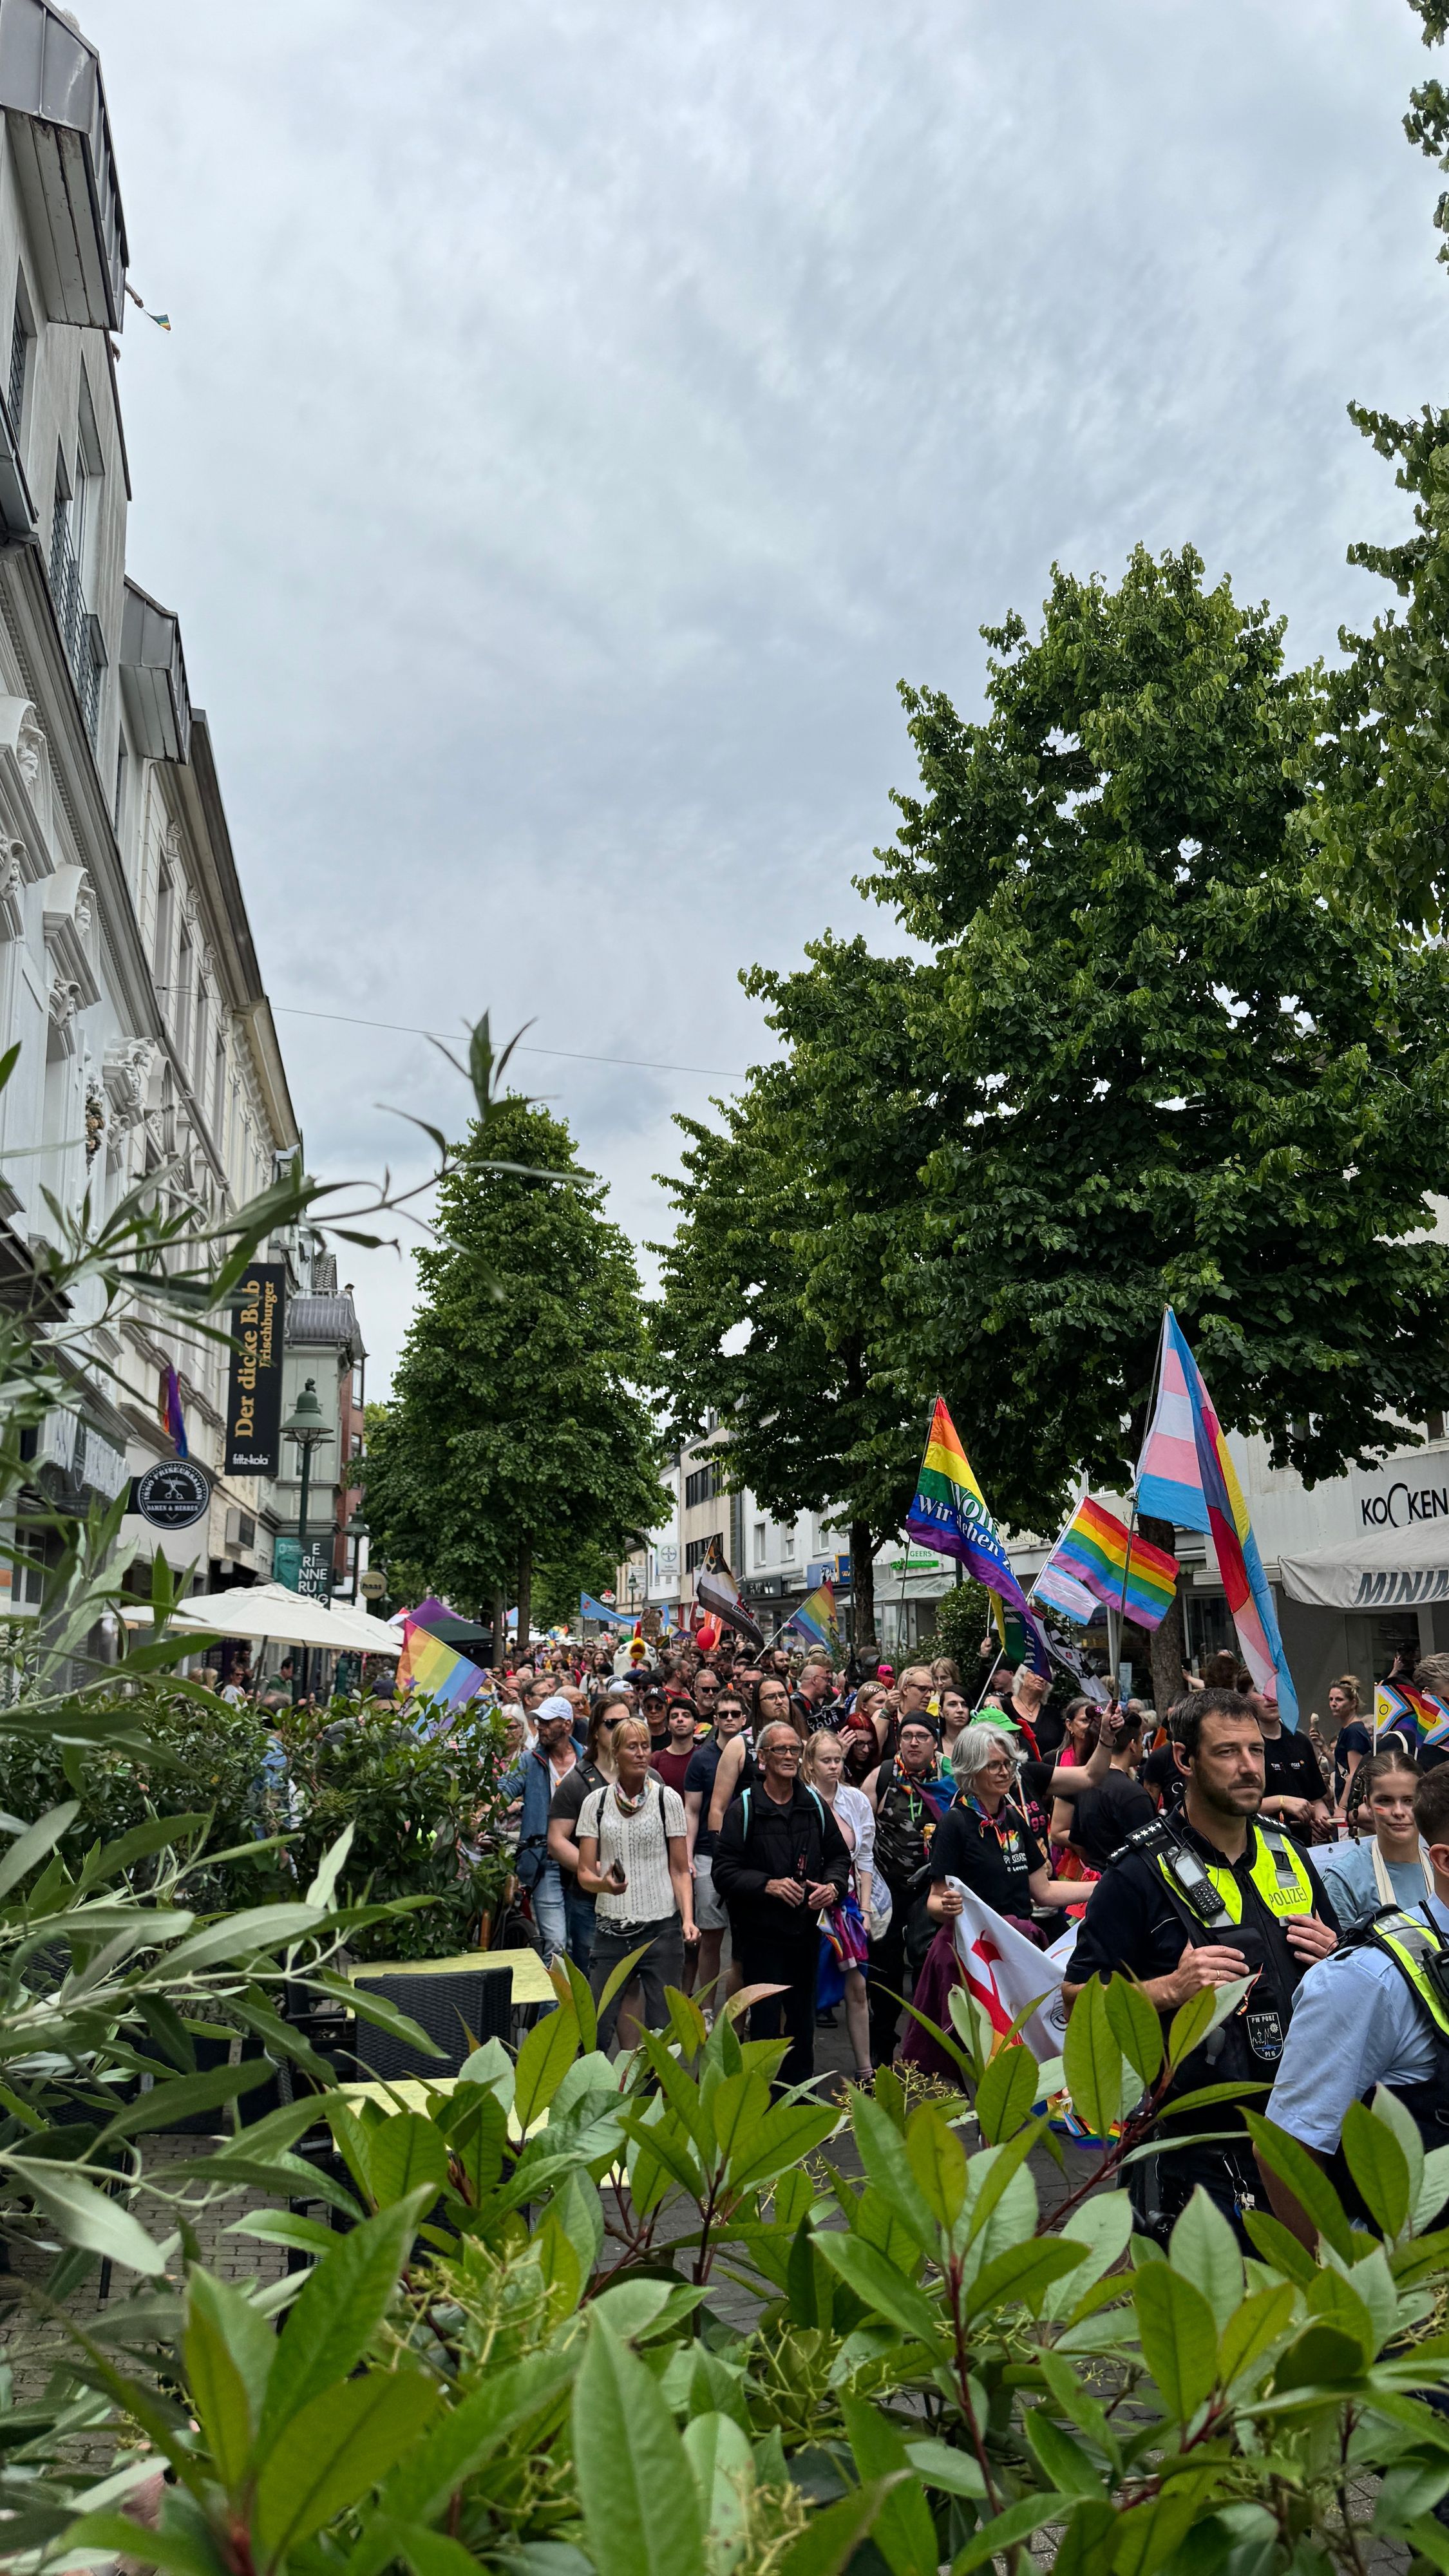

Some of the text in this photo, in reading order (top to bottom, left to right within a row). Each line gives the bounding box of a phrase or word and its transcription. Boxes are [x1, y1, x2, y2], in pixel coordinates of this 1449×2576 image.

[236, 1331, 258, 1390] dicke
[234, 1396, 254, 1437] Der
[232, 1453, 269, 1465] fritz-kola
[918, 1494, 953, 1522] Wir
[312, 1542, 321, 1555] E
[303, 1555, 315, 1567] RI
[298, 1568, 328, 1580] NNE
[807, 1709, 837, 1726] LIVE
[810, 1716, 839, 1732] YOUR
[1268, 1887, 1308, 1908] POLIZEI
